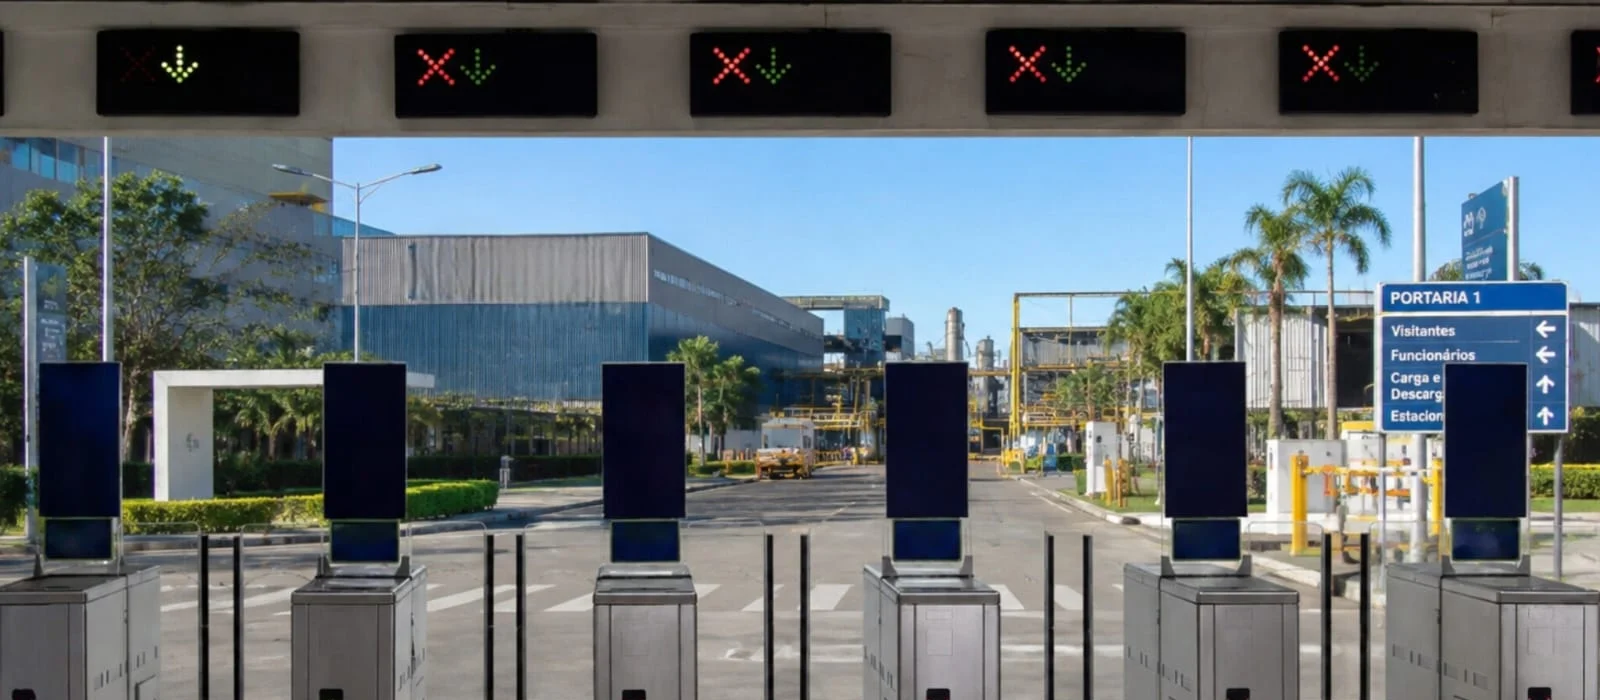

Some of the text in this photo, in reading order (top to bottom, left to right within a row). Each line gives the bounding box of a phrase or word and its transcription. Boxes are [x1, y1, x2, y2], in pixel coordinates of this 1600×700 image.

[1390, 290, 1481, 305] PORTARIA 1
[1391, 324, 1456, 337] Visitantes
[1391, 348, 1476, 361] Funcionários
[1390, 371, 1441, 386] Carga e
[1391, 388, 1443, 403] Descarg
[1391, 409, 1443, 422] Estacion
